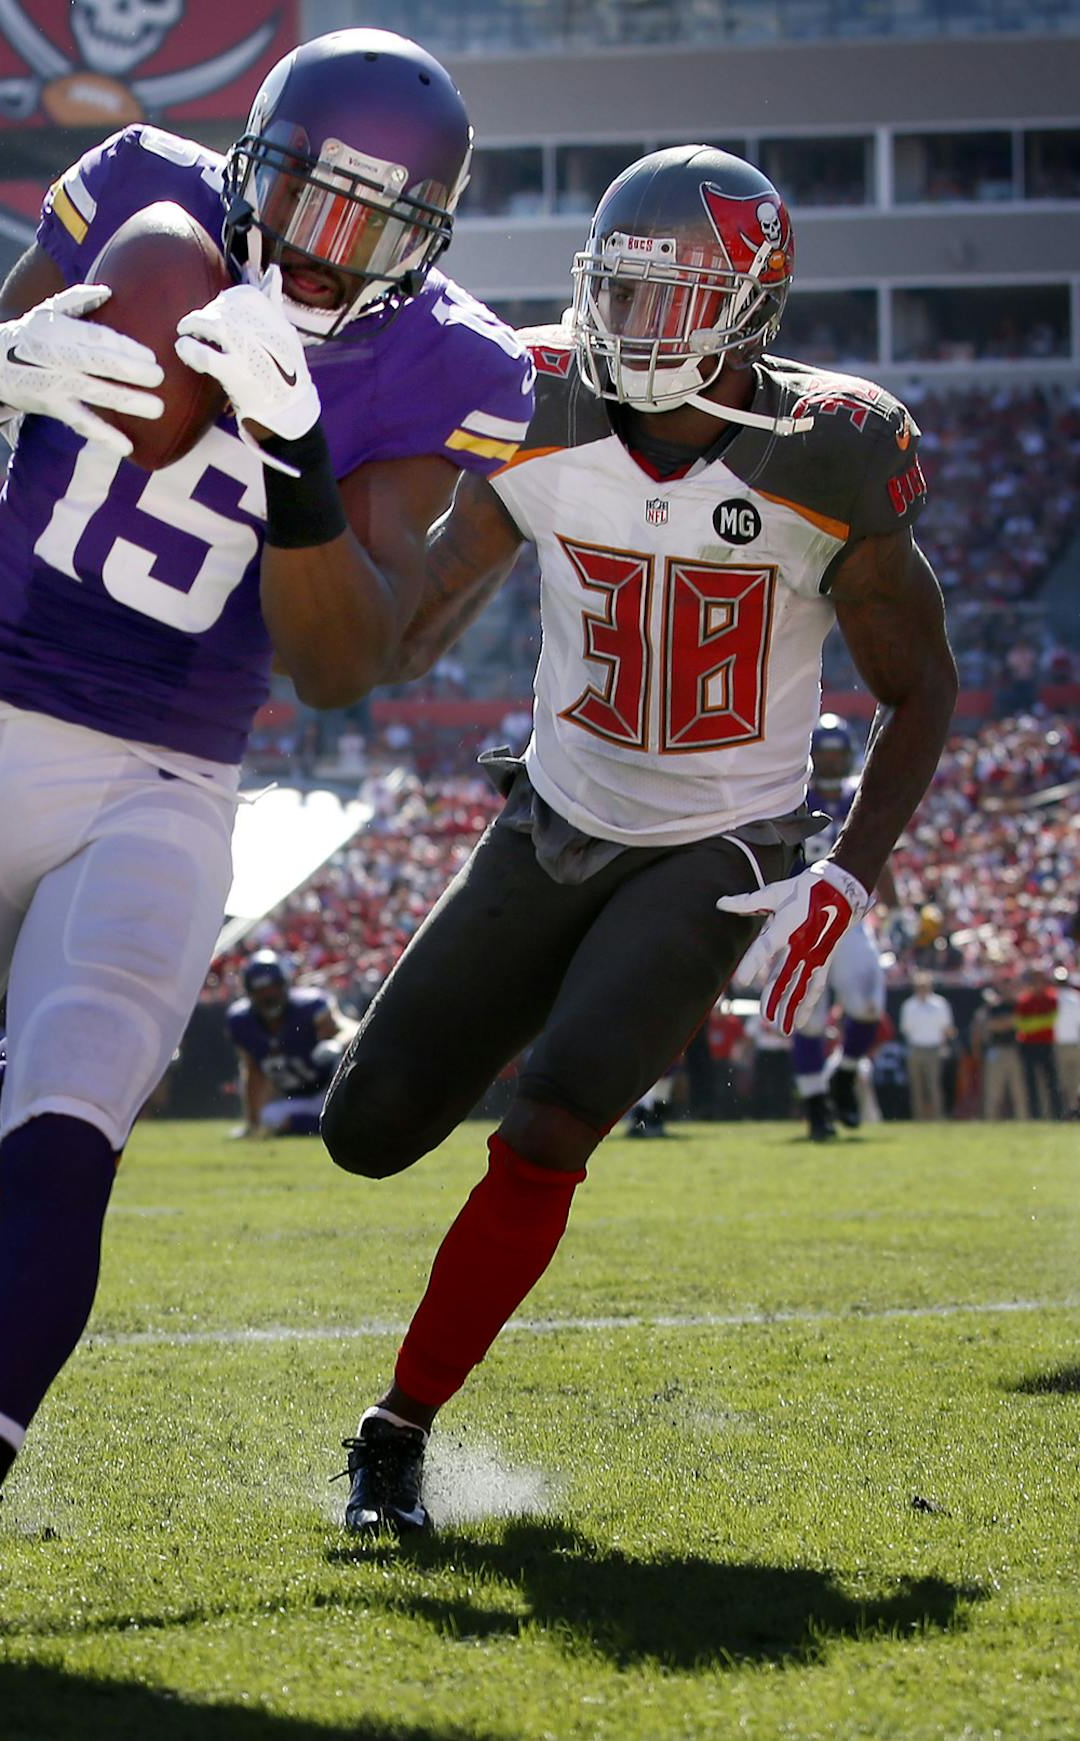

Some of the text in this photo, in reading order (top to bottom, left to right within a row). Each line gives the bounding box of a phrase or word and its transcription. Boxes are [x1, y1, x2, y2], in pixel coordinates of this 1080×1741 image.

[33, 424, 269, 635] 15
[719, 506, 756, 537] MG
[555, 532, 779, 755] 38
